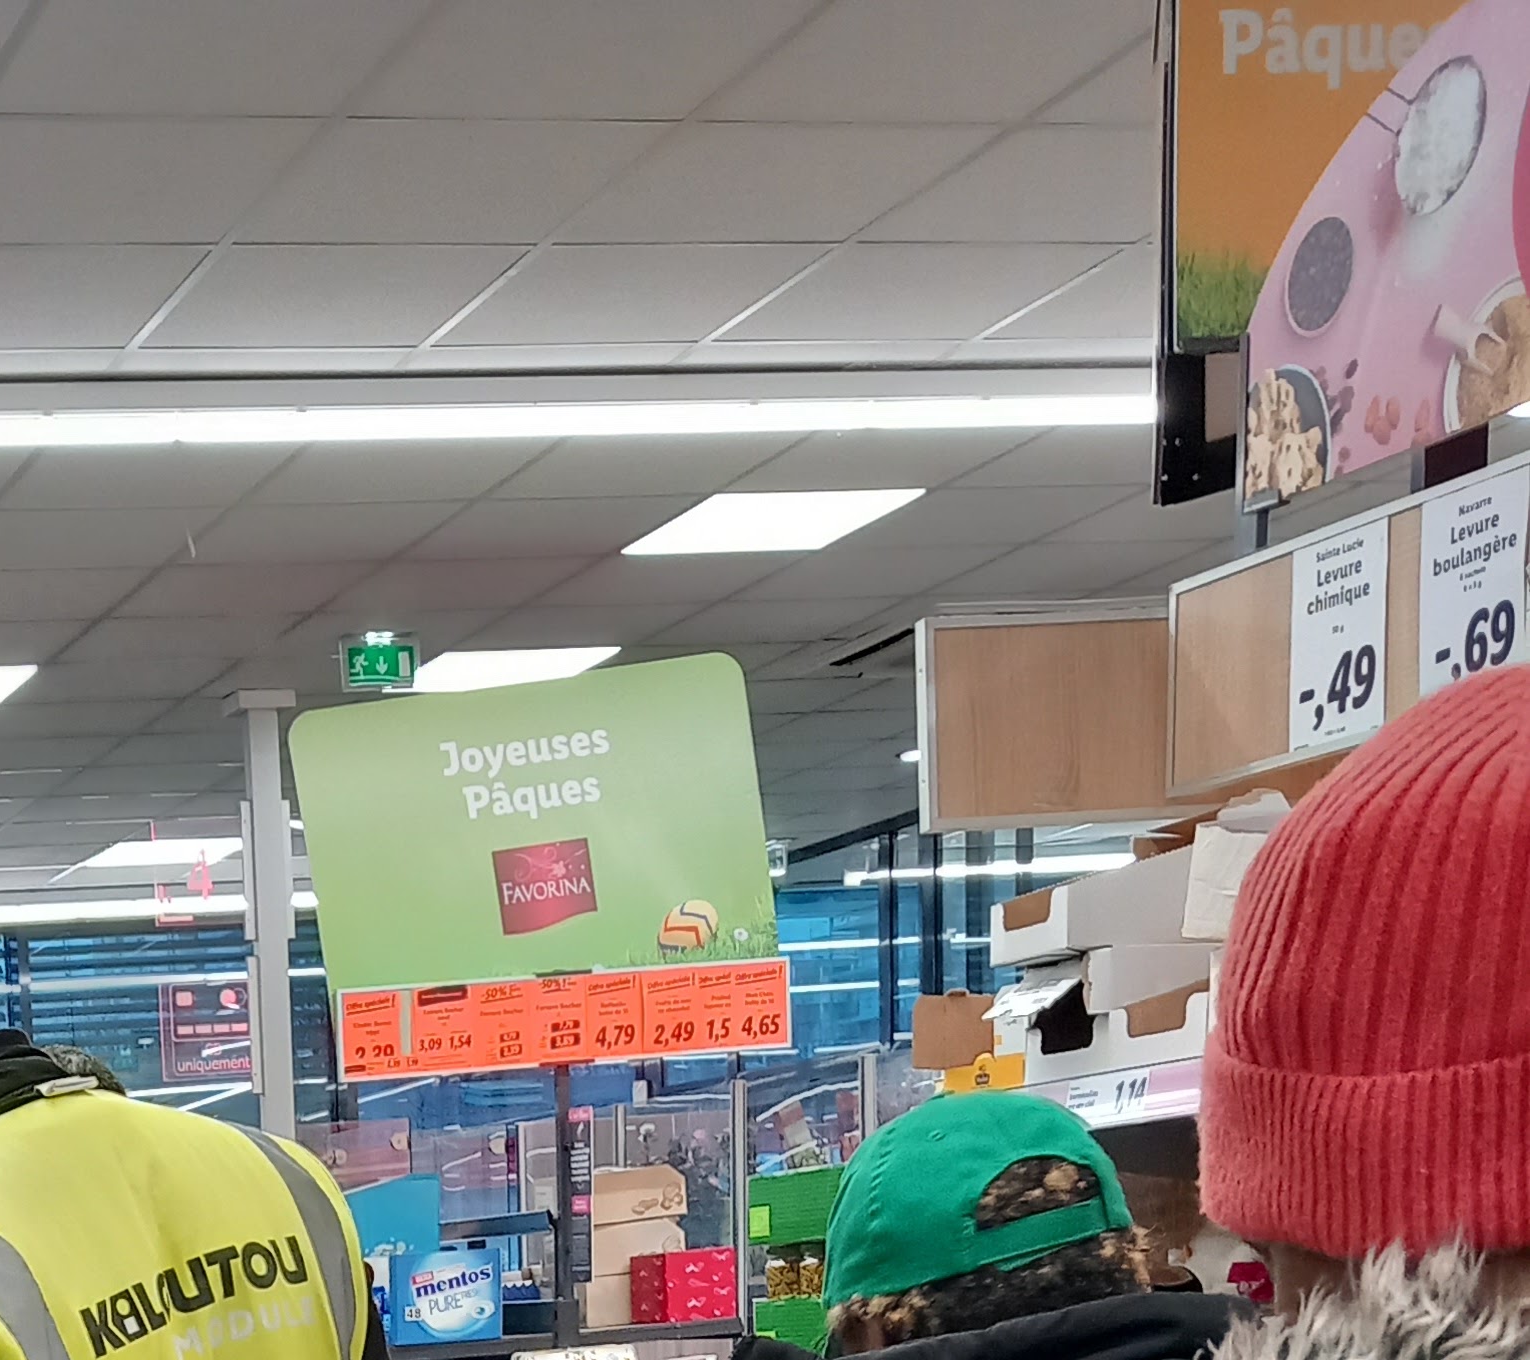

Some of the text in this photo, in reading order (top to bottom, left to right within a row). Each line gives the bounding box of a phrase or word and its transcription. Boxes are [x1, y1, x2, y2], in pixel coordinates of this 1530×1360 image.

[1218, 7, 1445, 91] Pâque
[1450, 513, 1500, 545] Levure
[1432, 532, 1518, 577] boulangère
[1316, 559, 1363, 588] Levure
[1306, 581, 1371, 615] chimique
[1298, 644, 1377, 732] -,49
[438, 727, 610, 778] Joyeuses
[462, 775, 602, 820] Pâques
[501, 875, 592, 906] FAVORINA
[595, 1023, 636, 1050] 4,79
[653, 1020, 695, 1048] 2,49
[740, 1013, 781, 1040] 4,65
[418, 1038, 442, 1053] 3,09
[449, 1034, 471, 1051] 1,54
[176, 1055, 251, 1074] uniquement
[416, 1267, 492, 1298] mentos
[406, 1307, 422, 1319] 48
[428, 1293, 464, 1315] PURE
